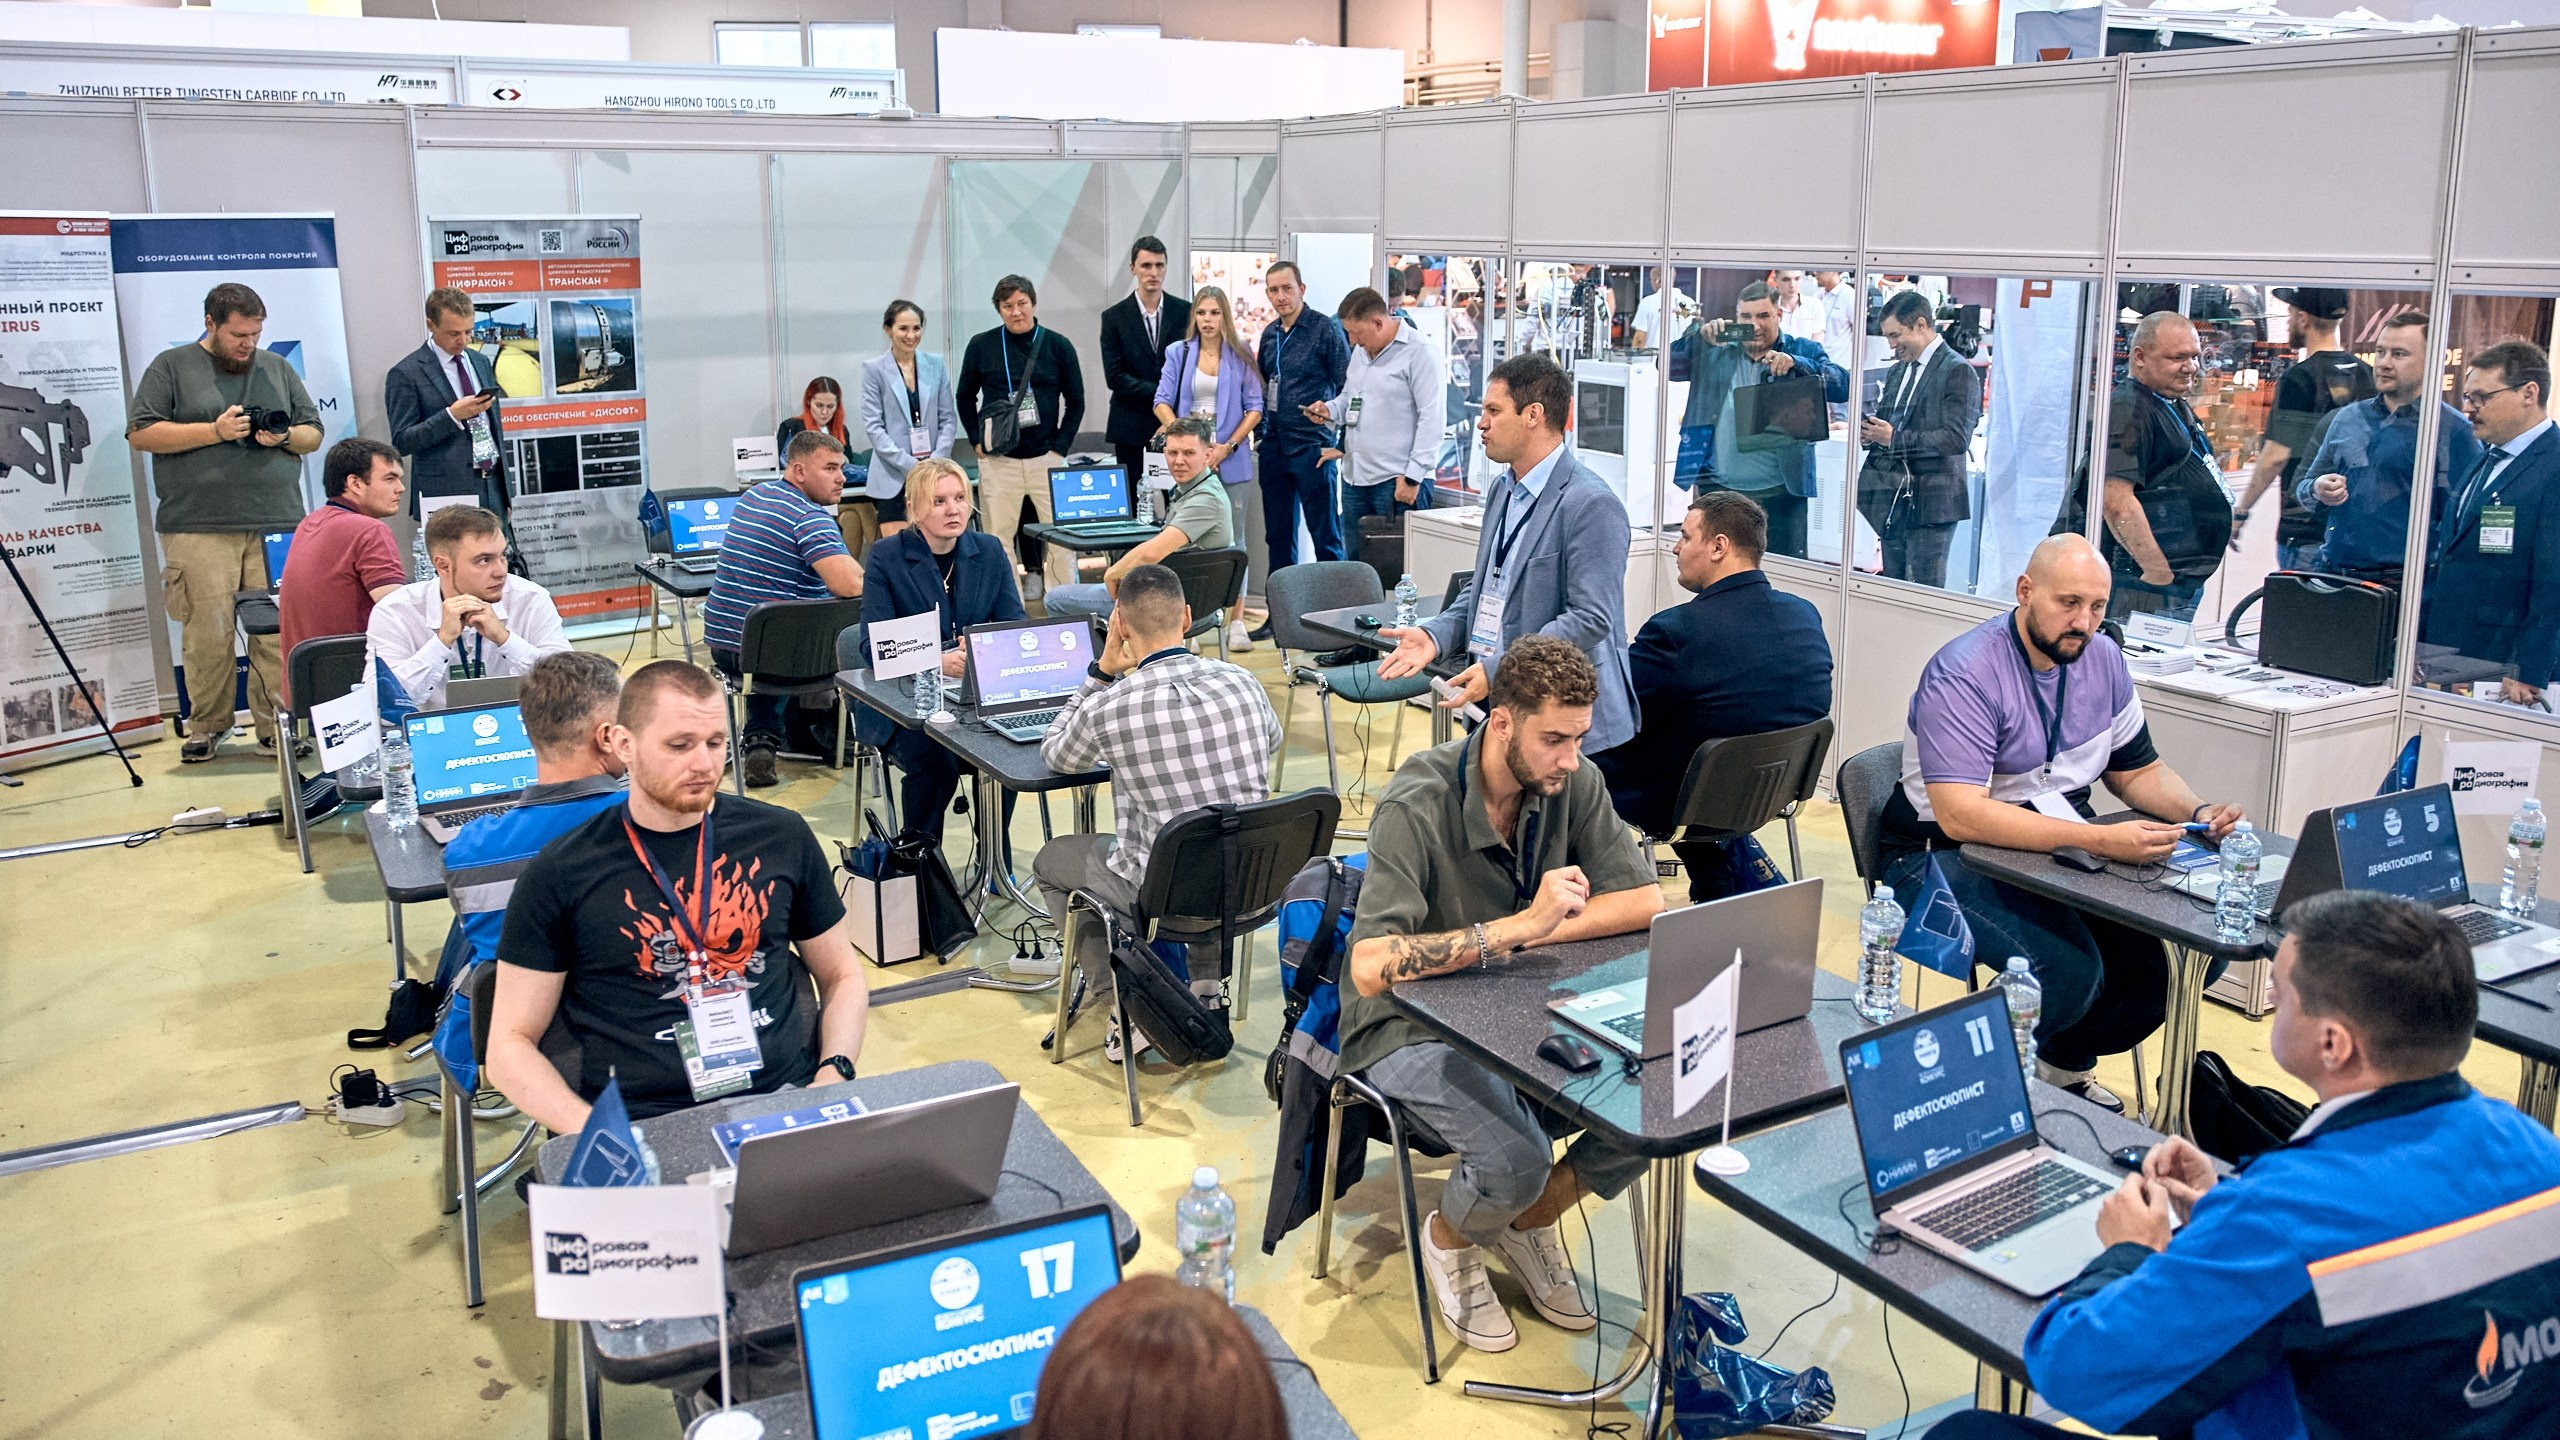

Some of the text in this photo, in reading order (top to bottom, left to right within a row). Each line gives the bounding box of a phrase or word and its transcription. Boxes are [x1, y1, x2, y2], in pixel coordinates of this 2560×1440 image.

[246, 90, 298, 101] CARBIDE
[604, 96, 776, 110] HANGZHOU HIRONO TOOLS CO.,LTD
[444, 232, 500, 244] Цифровая
[454, 242, 524, 254] радиография
[137, 251, 318, 262] ОБОРУДОВАНИЕ КОНТРОЛЯ ПОКРЫТИЙ
[448, 278, 506, 288] ЦИФРАКОН
[548, 276, 601, 286] ТРАНСКАН
[49, 302, 104, 313] ПРОЕКТ
[0, 320, 40, 332] IRUS
[526, 410, 586, 422] ОБЕСПЕЧЕНИЕ
[590, 406, 638, 417] «ДИСОФТ»
[1109, 473, 1117, 488] 1
[45, 500, 131, 512] ТЕХНОЛОГИИ ПРОИЗВОДСТВА
[28, 522, 102, 540] КАЧЕСТВА
[1, 544, 56, 559] ВАРКИ
[28, 607, 145, 629] НАУО-МЕТОДИЧЕСКОЕ ОБЕСПЕЧЕНИЕ
[877, 639, 918, 652] Цифровая
[1059, 630, 1077, 651] 9
[885, 642, 933, 658] радиография
[1000, 661, 1068, 678] ДЕФЕКТОСКОПИСТ
[9, 674, 52, 686] WORLDSKILLS
[2454, 770, 2504, 780] Цифровая
[2460, 779, 2528, 790] радиография
[2423, 804, 2440, 832] 5
[2368, 850, 2433, 878] ДЕФЕКТОСКОПИСТ
[1965, 1016, 1994, 1057] 11
[1893, 1080, 1985, 1132] ДЕФЕКТОСКОПИСТ
[546, 1236, 649, 1256] Цифровая
[560, 1254, 698, 1273] радиография
[1020, 1240, 1075, 1299] 17
[876, 1326, 1056, 1392] ДЕФЕКТОСКОПИСТ
